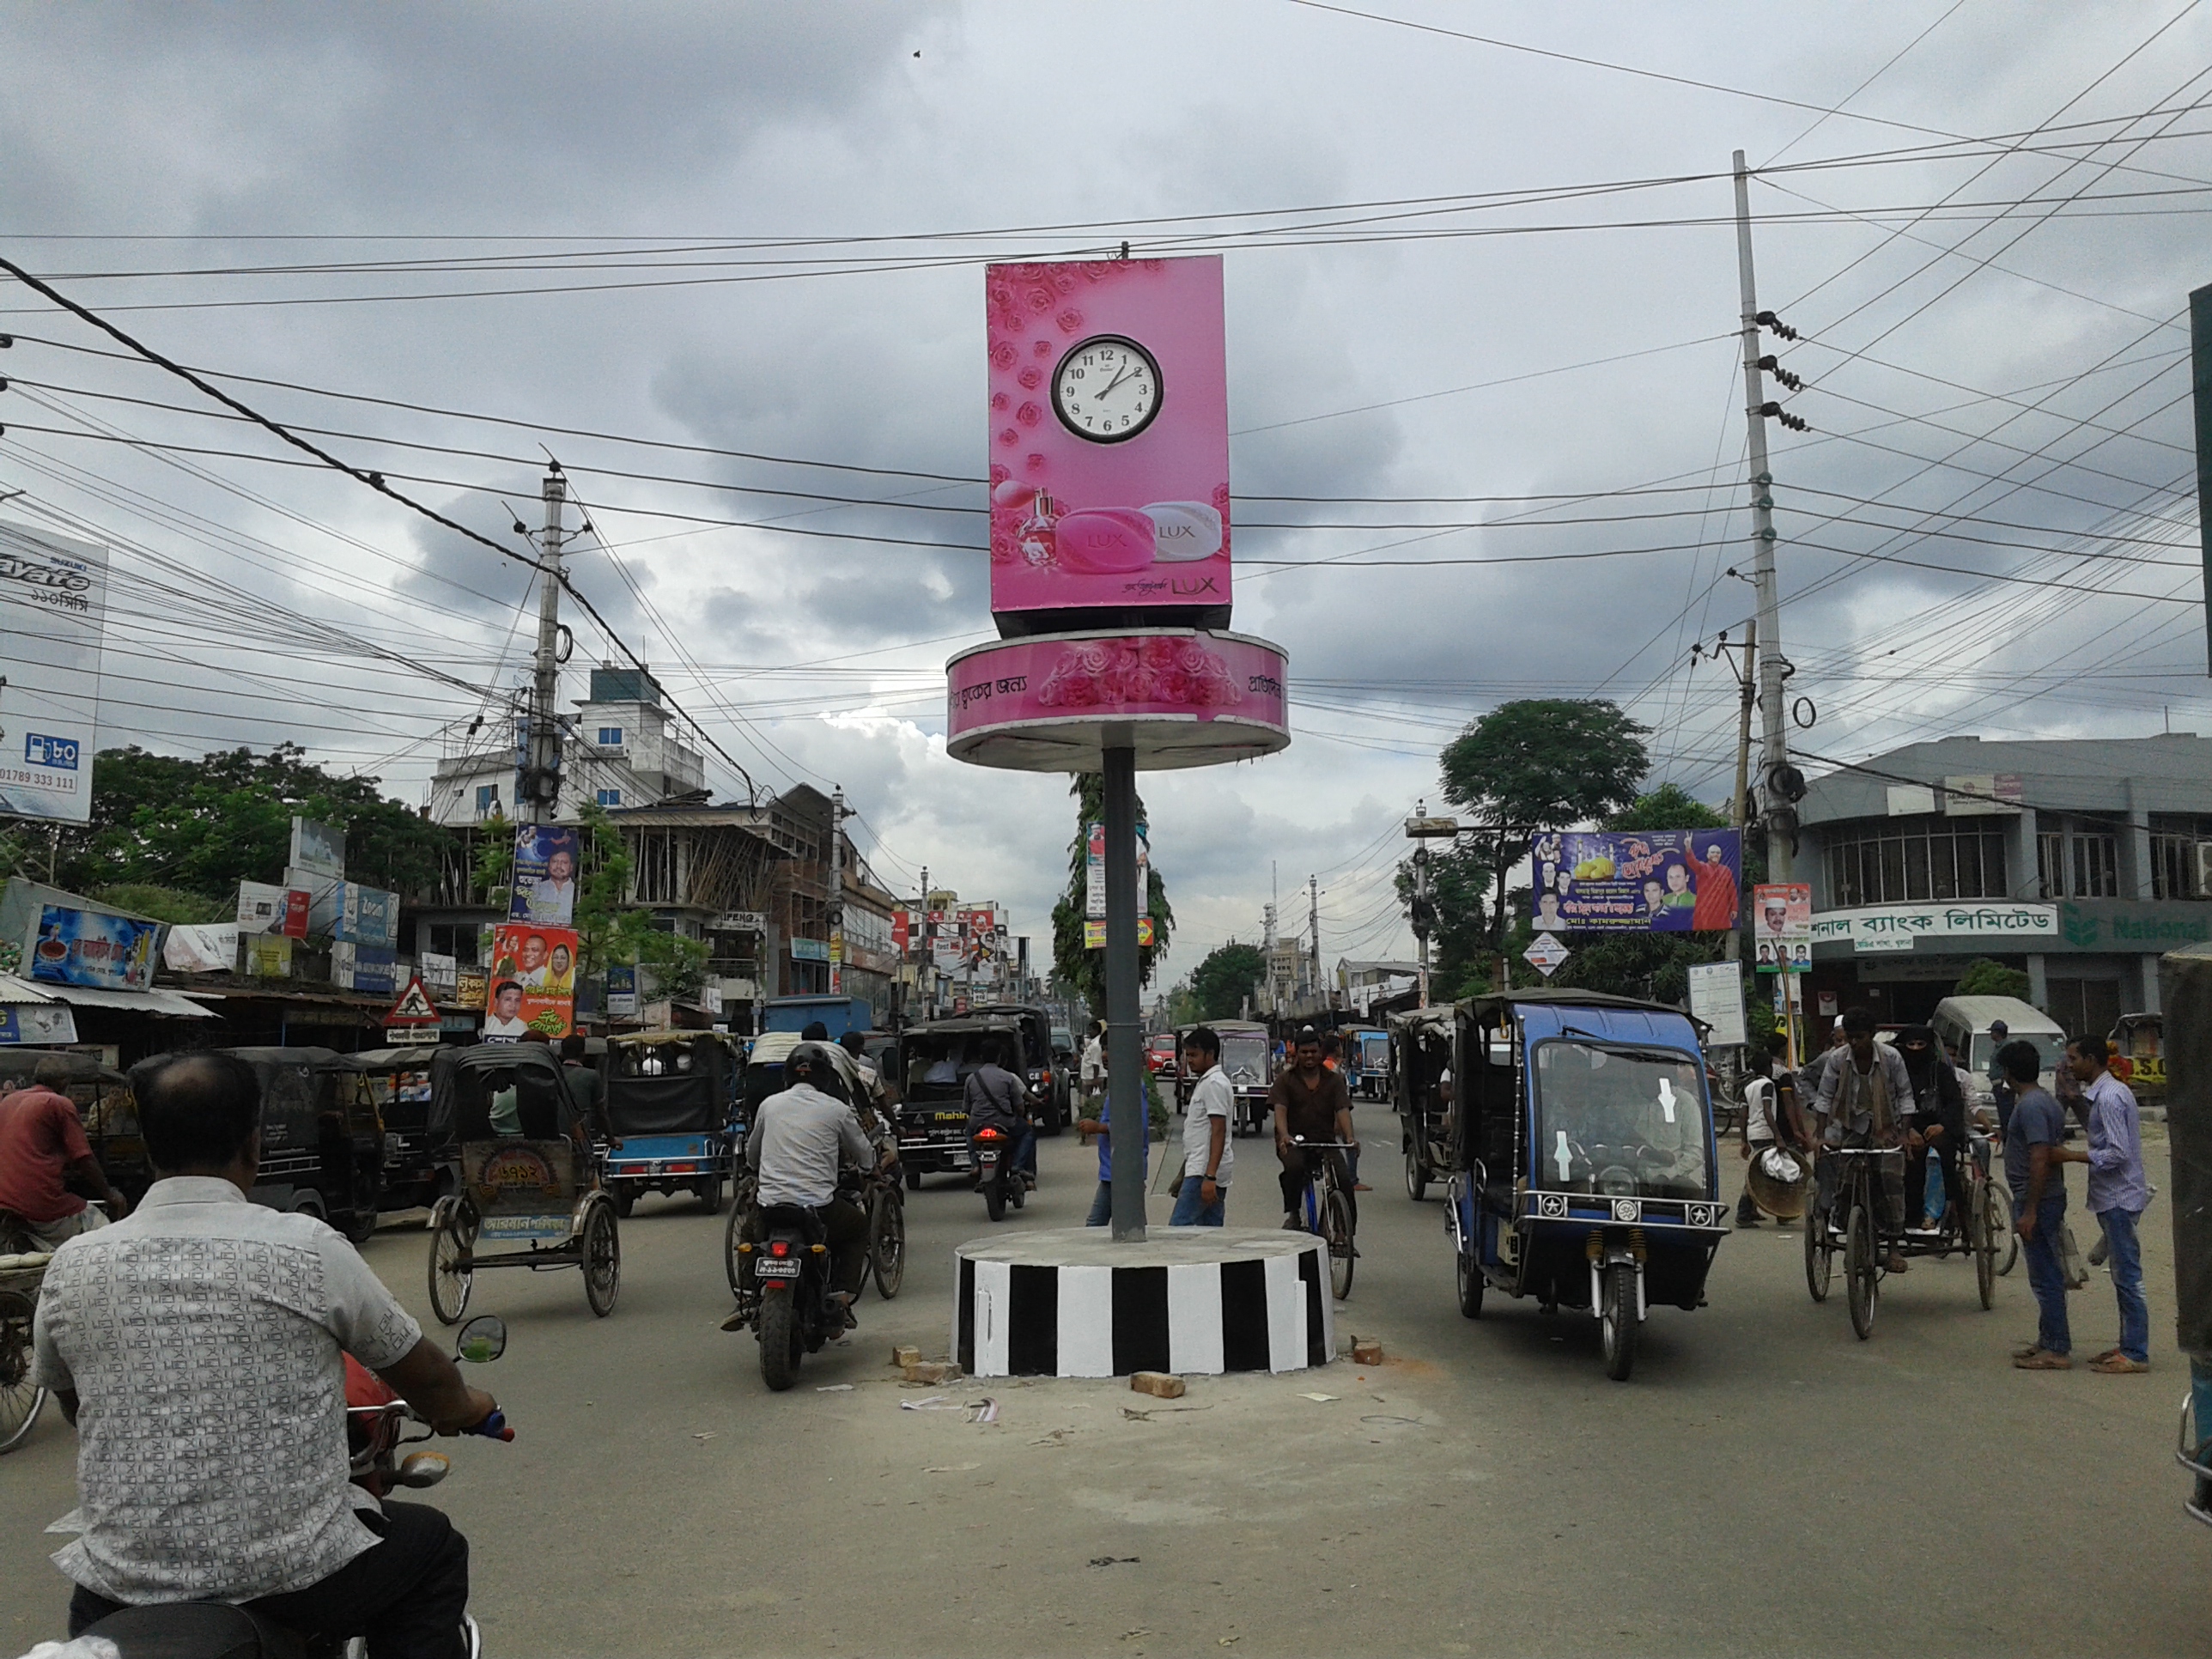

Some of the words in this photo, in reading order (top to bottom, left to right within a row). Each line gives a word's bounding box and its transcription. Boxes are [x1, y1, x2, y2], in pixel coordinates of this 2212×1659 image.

[1082, 355, 1094, 366] 11
[1100, 349, 1114, 361] 12
[1121, 354, 1127, 365] 1
[1070, 368, 1085, 380] 10
[1066, 386, 1075, 398] 9
[1139, 384, 1148, 395] 3
[1071, 403, 1081, 415] 8
[1134, 401, 1143, 413] 4
[1085, 416, 1094, 427] 7
[1103, 420, 1113, 432] 6
[1121, 415, 1130, 427] 5
[1159, 525, 1196, 540] LUX
[1087, 533, 1128, 550] LUX
[1171, 577, 1219, 596] LUX
[996, 676, 1028, 694] জন্য
[52, 740, 76, 761] ৮০
[34, 773, 52, 787] 333
[56, 776, 74, 789] 111
[1810, 918, 1851, 937] শনাল
[1859, 914, 1933, 933] ব্যাংক
[1942, 908, 2050, 929] লিমিটেড
